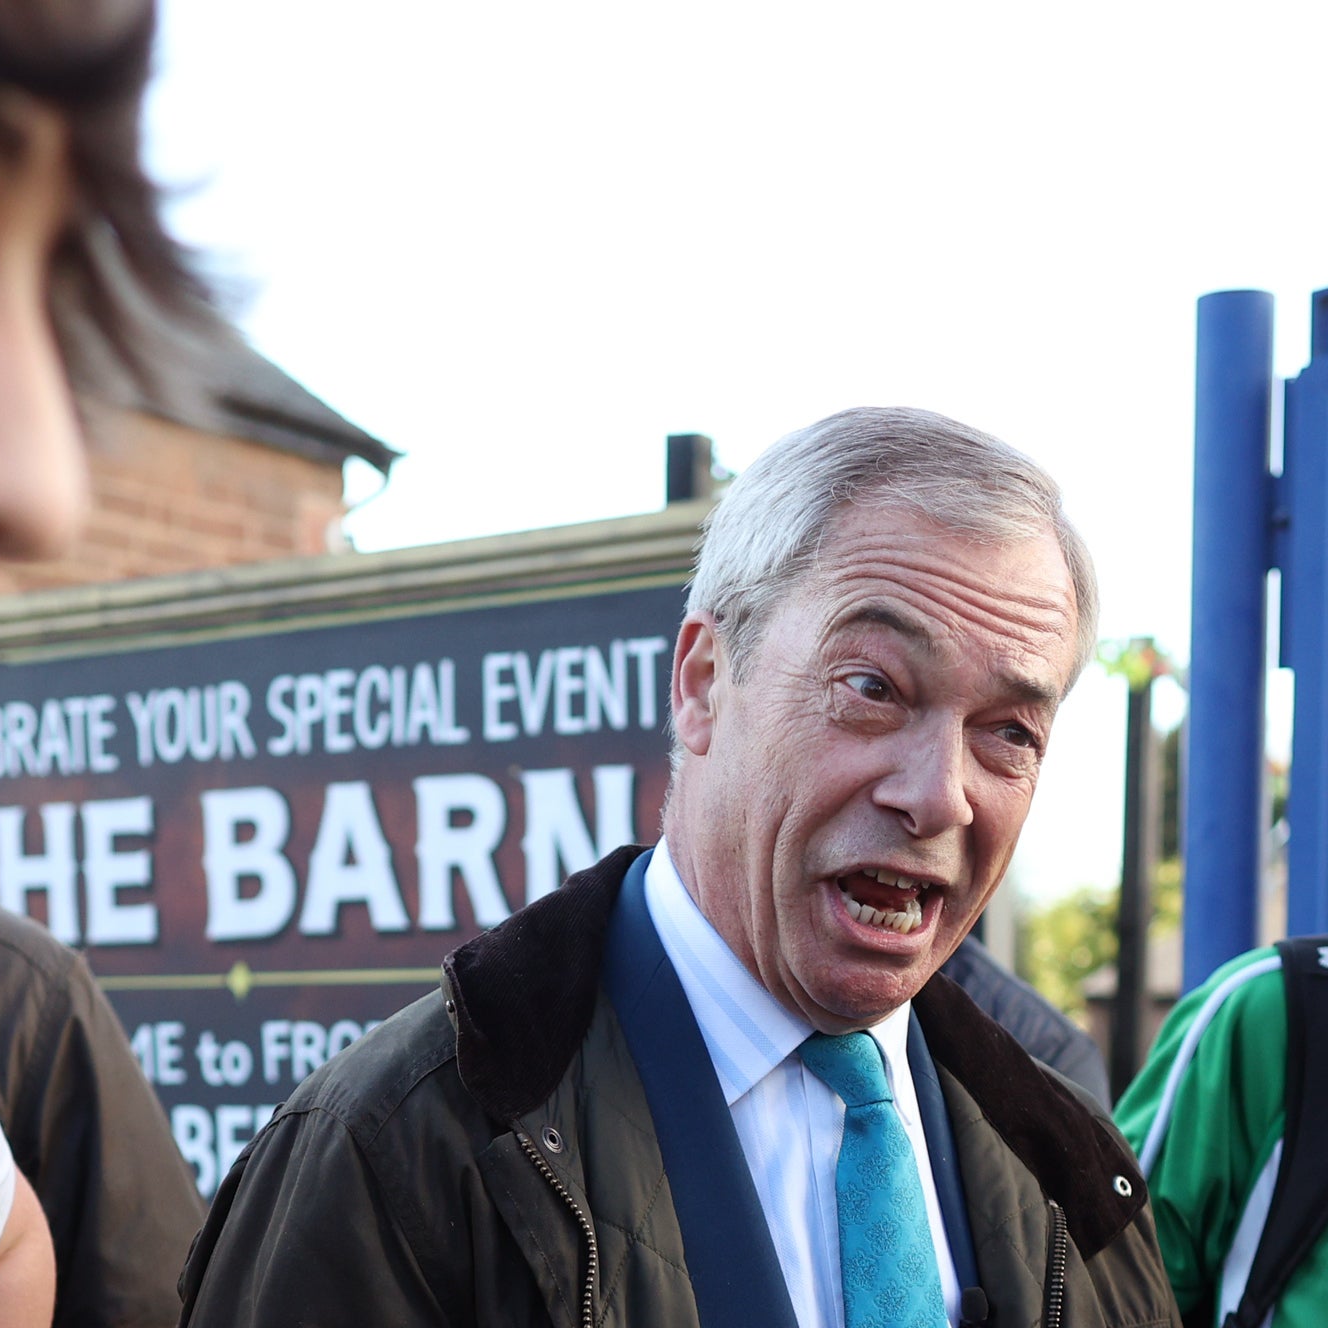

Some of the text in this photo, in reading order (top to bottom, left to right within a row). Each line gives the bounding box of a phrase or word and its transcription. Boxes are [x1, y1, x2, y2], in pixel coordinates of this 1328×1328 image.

[125, 680, 258, 767] YOUR
[266, 658, 471, 757] SPECIAL
[482, 635, 668, 742] EVENT
[200, 763, 635, 942] BARN
[194, 1028, 254, 1088] to
